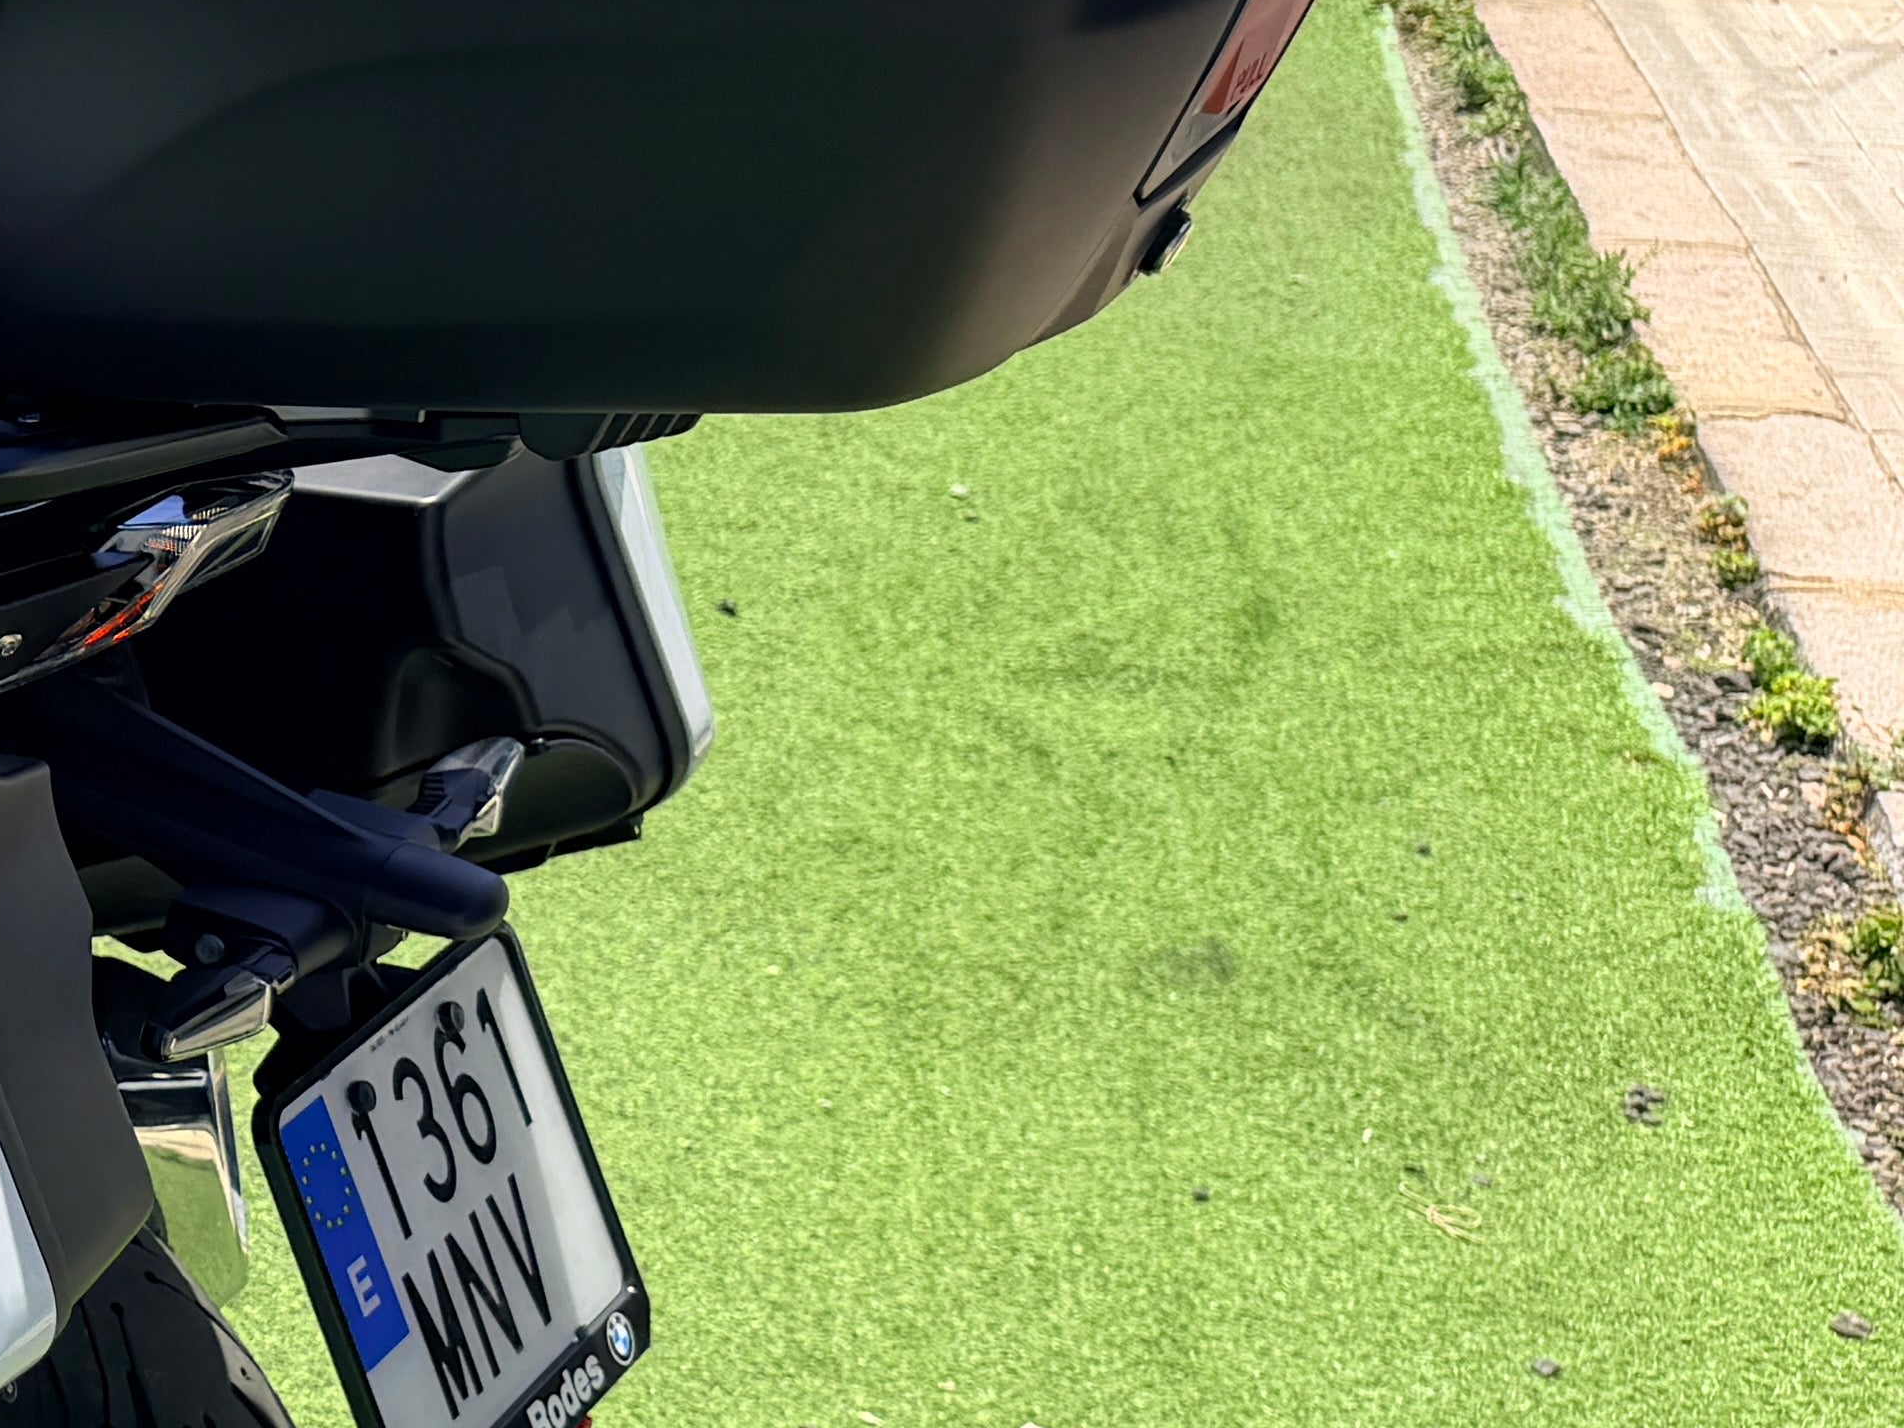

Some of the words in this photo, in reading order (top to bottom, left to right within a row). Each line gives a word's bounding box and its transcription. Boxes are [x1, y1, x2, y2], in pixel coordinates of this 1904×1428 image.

[350, 987, 533, 1240] 1361
[347, 1255, 381, 1318] E
[401, 1173, 553, 1420] MNV
